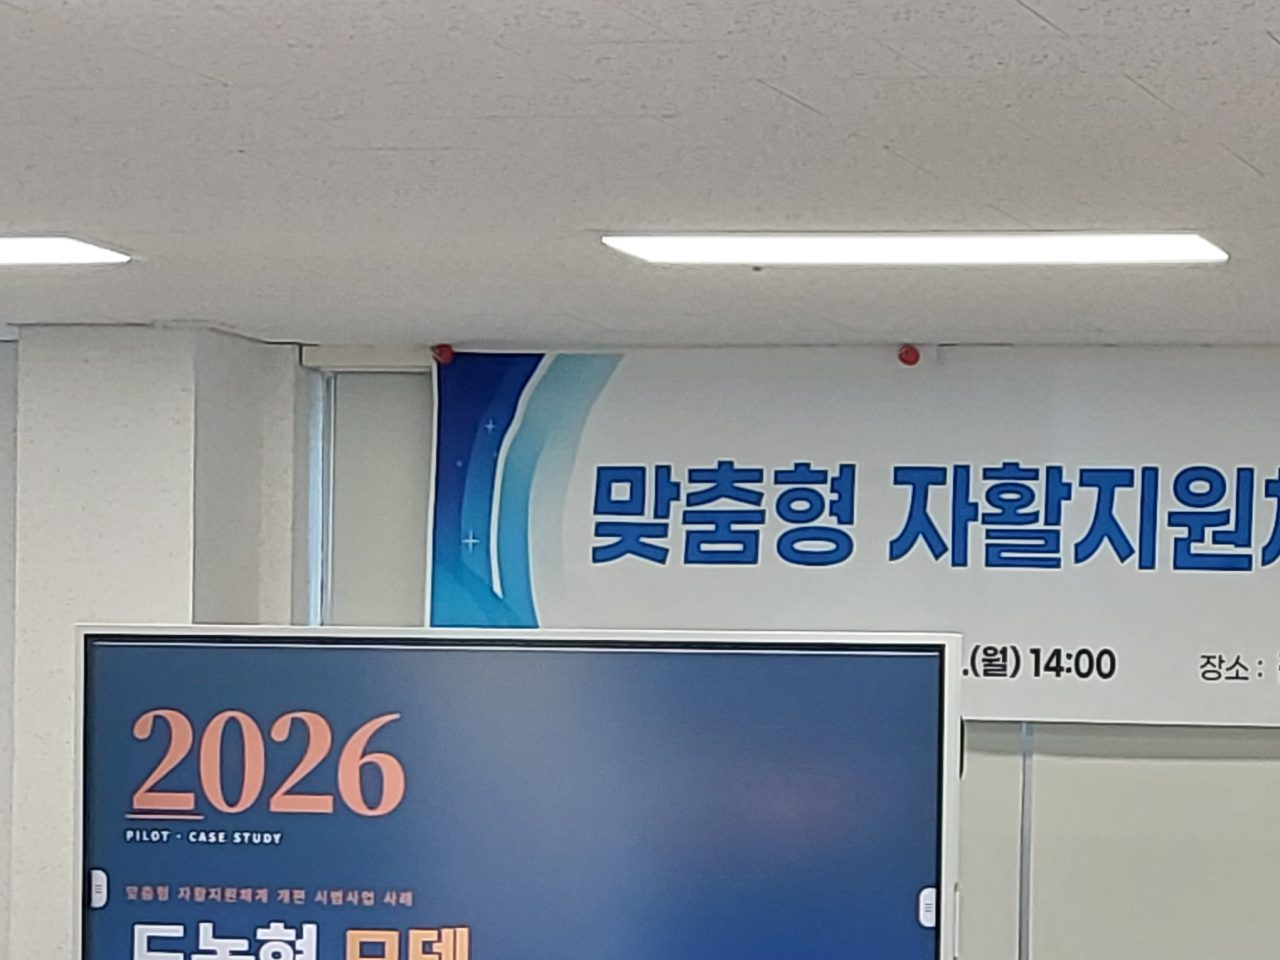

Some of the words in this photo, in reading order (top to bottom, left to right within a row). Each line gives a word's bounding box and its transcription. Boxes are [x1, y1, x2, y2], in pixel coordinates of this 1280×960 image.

[591, 460, 856, 567] 맞춤형
[1029, 648, 1117, 680] 14:00
[132, 708, 406, 817] 2026
[125, 830, 171, 842] PILOT
[188, 831, 226, 843] CASE
[233, 832, 282, 845] STUDY
